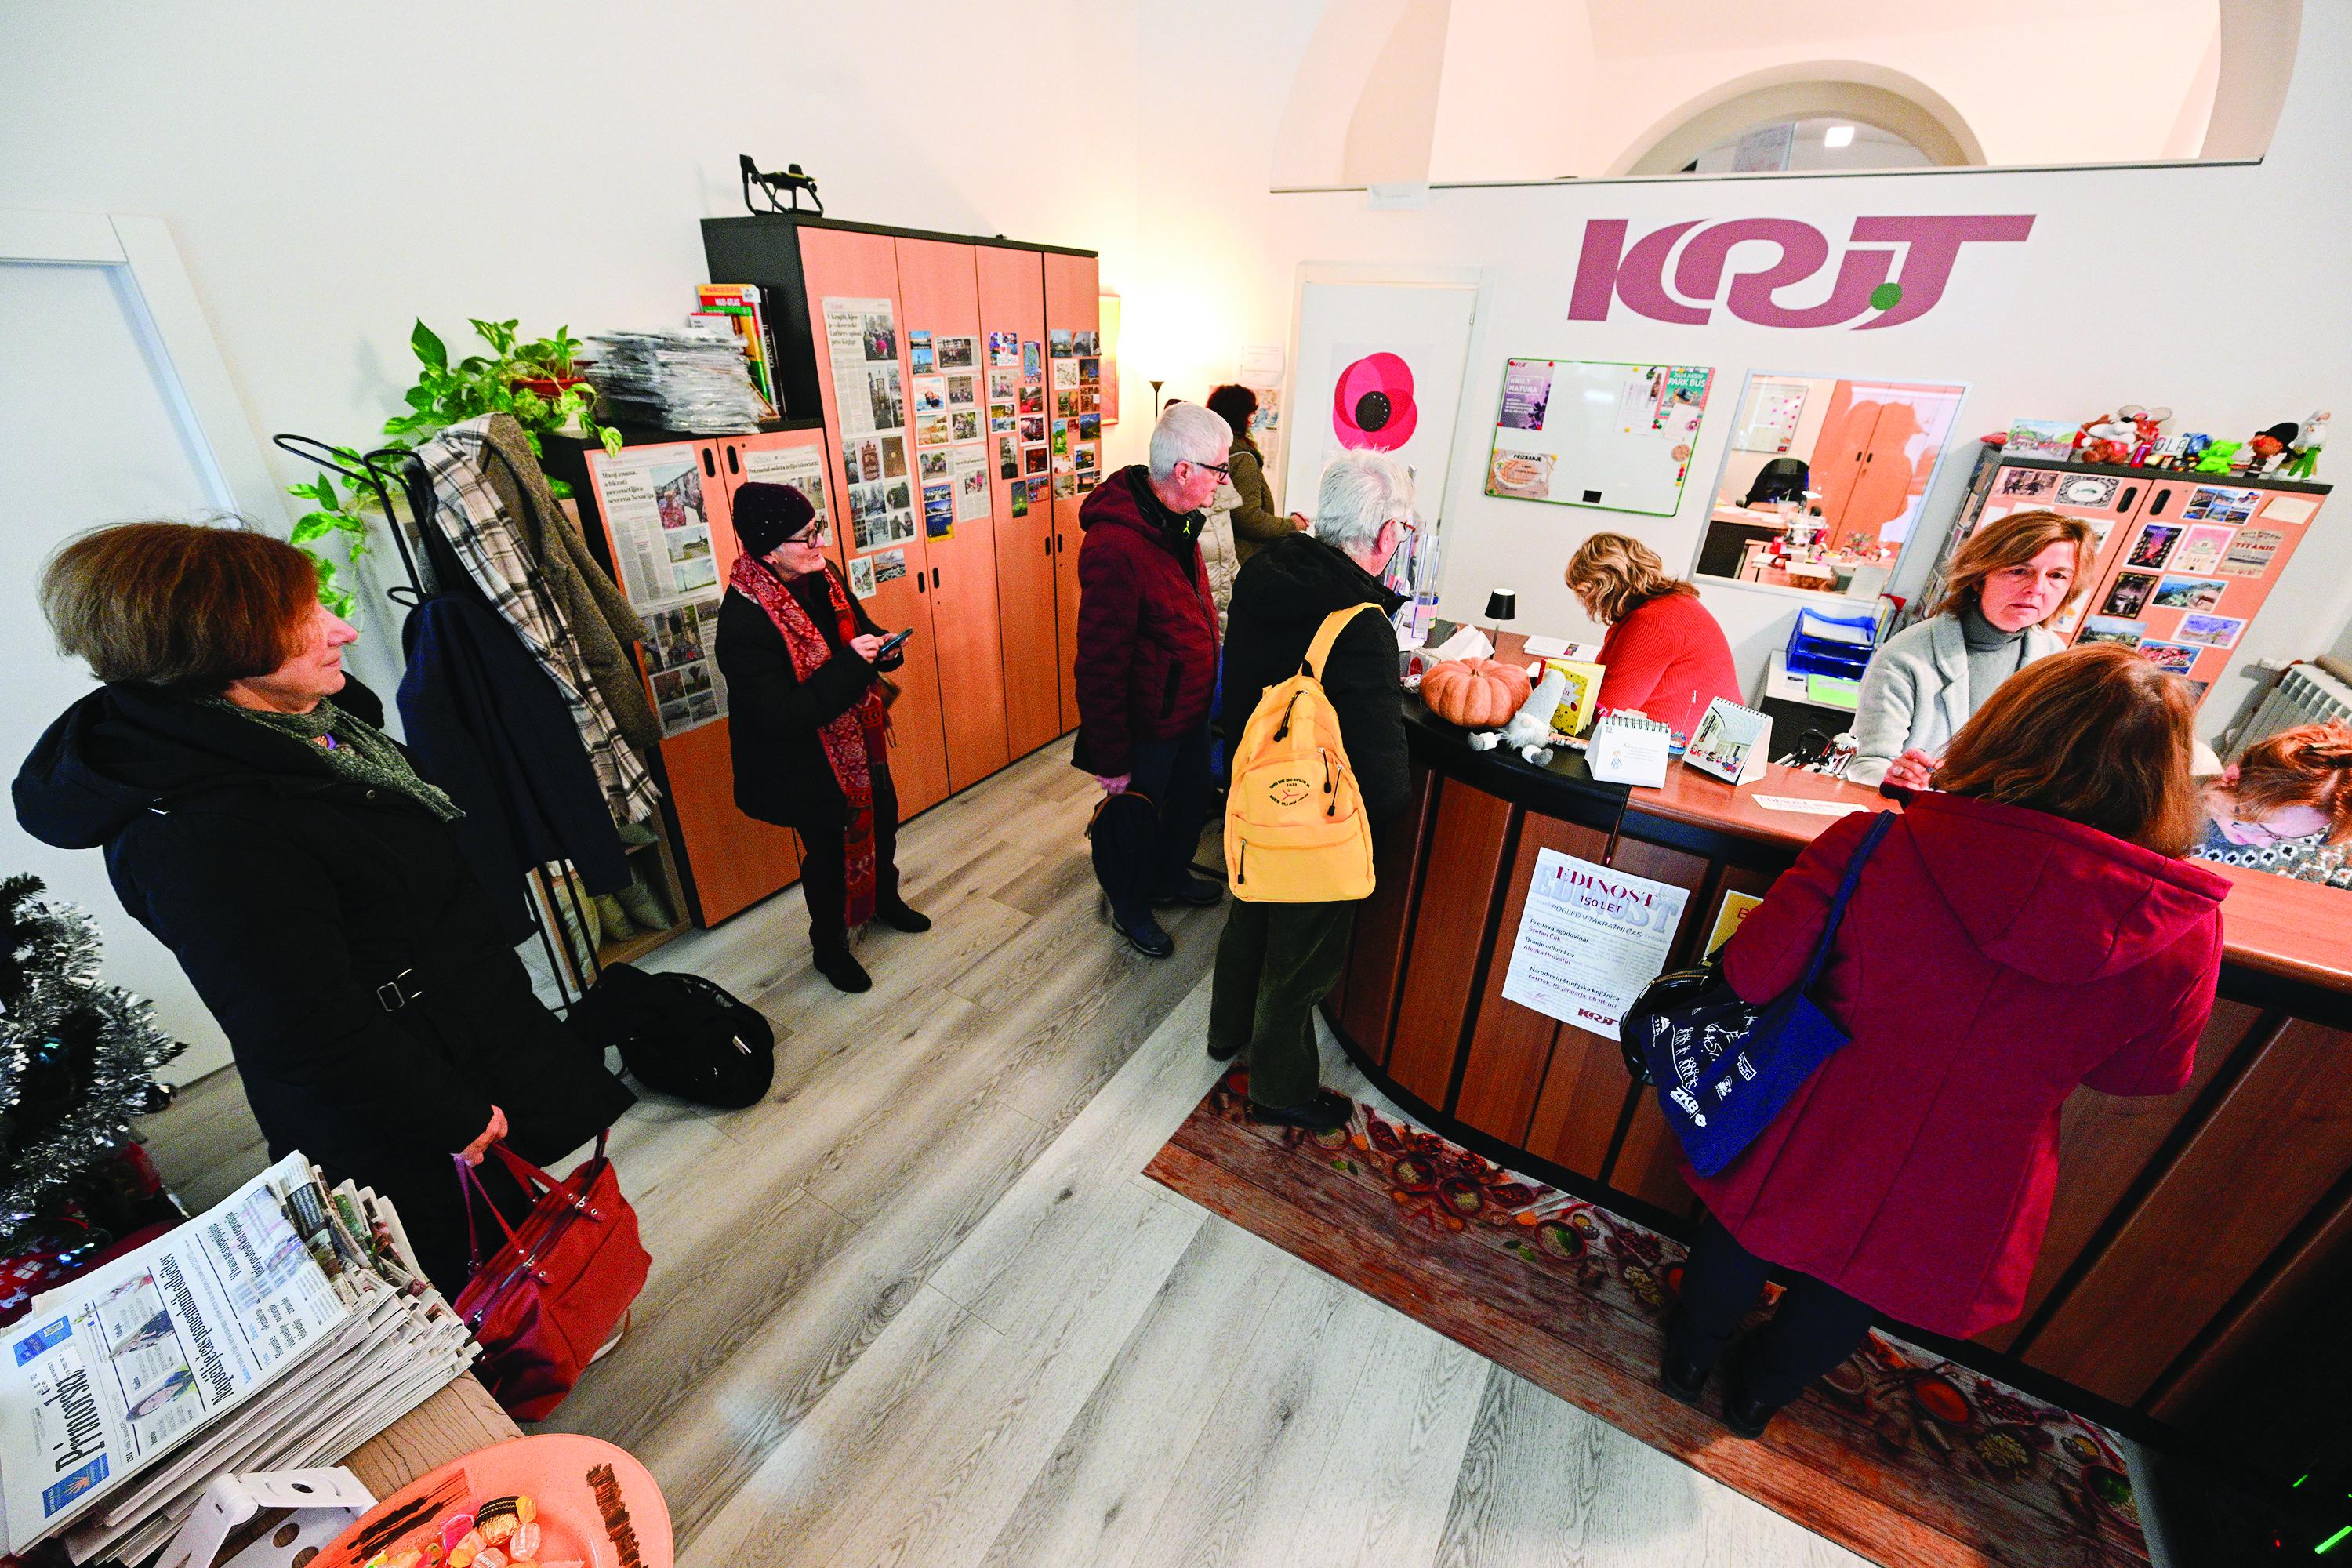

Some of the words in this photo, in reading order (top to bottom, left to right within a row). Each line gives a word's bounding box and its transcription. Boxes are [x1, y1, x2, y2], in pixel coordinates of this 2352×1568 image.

[2235, 542, 2276, 552] TITANIC
[1555, 865, 1657, 908] EDINOST
[1579, 895, 1598, 907] 150
[1600, 901, 1622, 914] LET
[1530, 918, 1554, 931] Predava
[1555, 928, 1589, 942] zgodovinar
[1550, 904, 1581, 918] POGLED
[1587, 917, 1626, 933] TAKRATNI
[1626, 927, 1642, 937] ČAS
[1523, 944, 1543, 955] Alenka
[1525, 937, 1544, 947] Branje
[1545, 943, 1575, 958] odlomkov
[1529, 966, 1555, 979] Narodna
[1591, 987, 1620, 1001] knjižnica
[1671, 1087, 1699, 1114] ZKB
[223, 1210, 244, 1238] represija
[206, 1221, 229, 1255] stopnjujejo
[236, 1232, 249, 1246] kot
[222, 1249, 232, 1260] se
[225, 1256, 238, 1274] Iranu
[240, 1240, 262, 1266] protesti
[158, 1251, 185, 1293] odločitev
[229, 1268, 241, 1280] V
[250, 1260, 265, 1279] tako
[170, 1287, 212, 1341] pomembnih
[195, 1336, 214, 1362] čas
[268, 1334, 283, 1358] Slovenske
[199, 1360, 234, 1406] Napočil
[41, 1366, 105, 1472] Primorski
